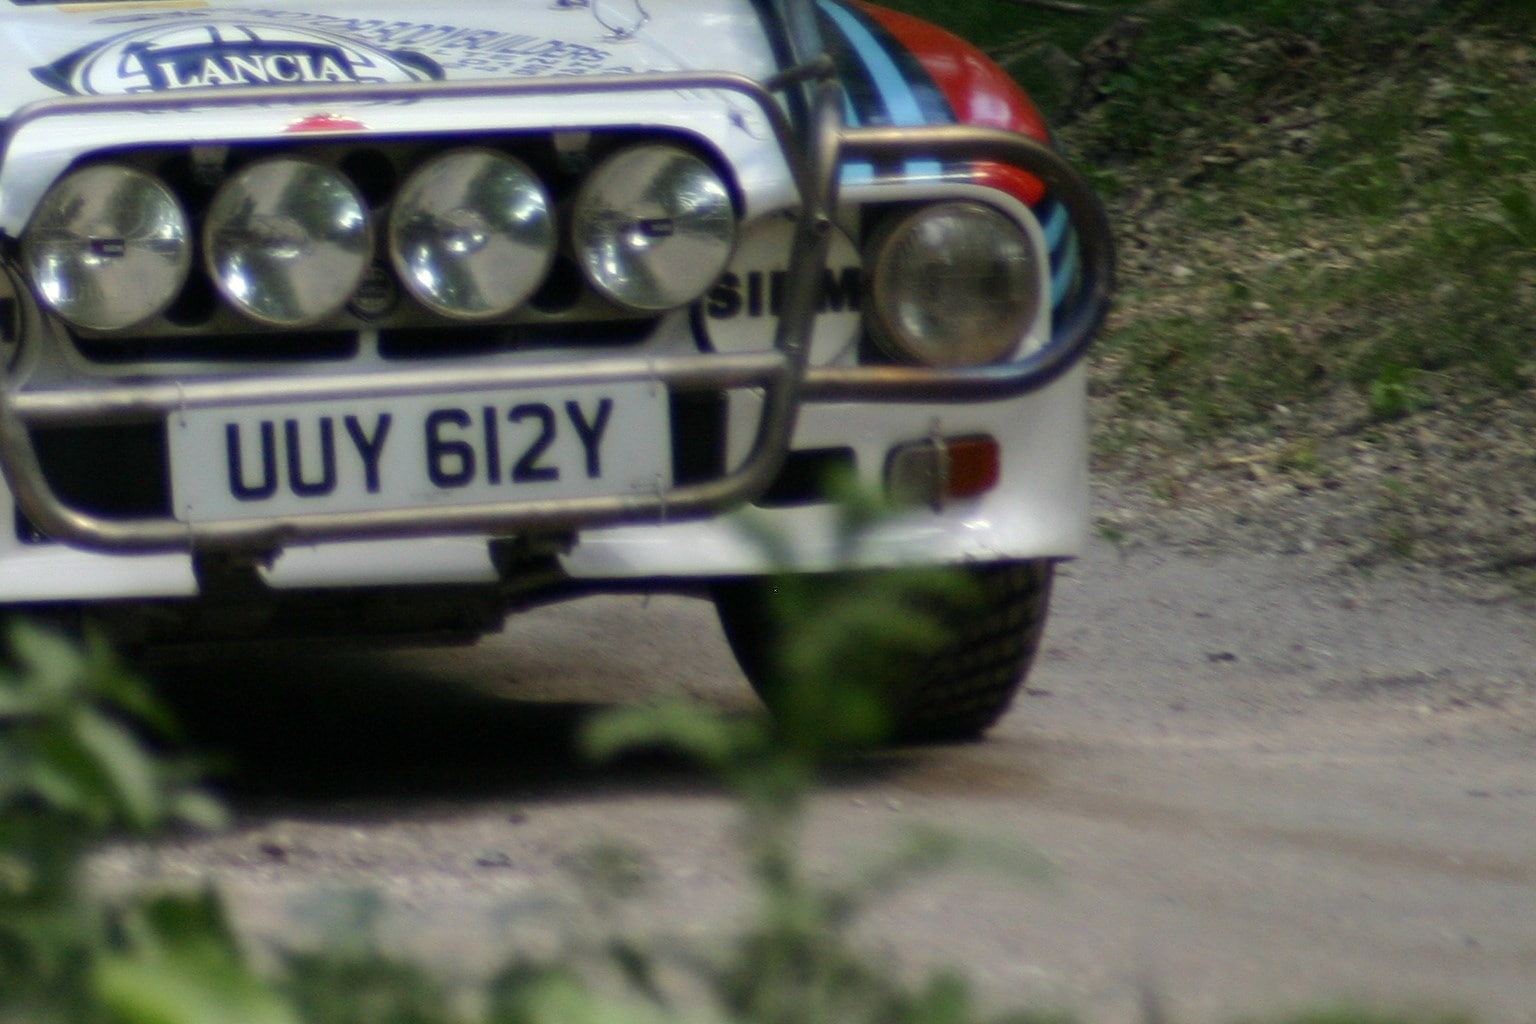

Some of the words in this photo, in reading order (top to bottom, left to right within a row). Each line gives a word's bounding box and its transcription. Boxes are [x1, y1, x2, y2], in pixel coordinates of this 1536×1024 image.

[156, 52, 356, 90] LANCIA
[224, 412, 393, 503] UUY
[424, 396, 615, 490] 612Y
